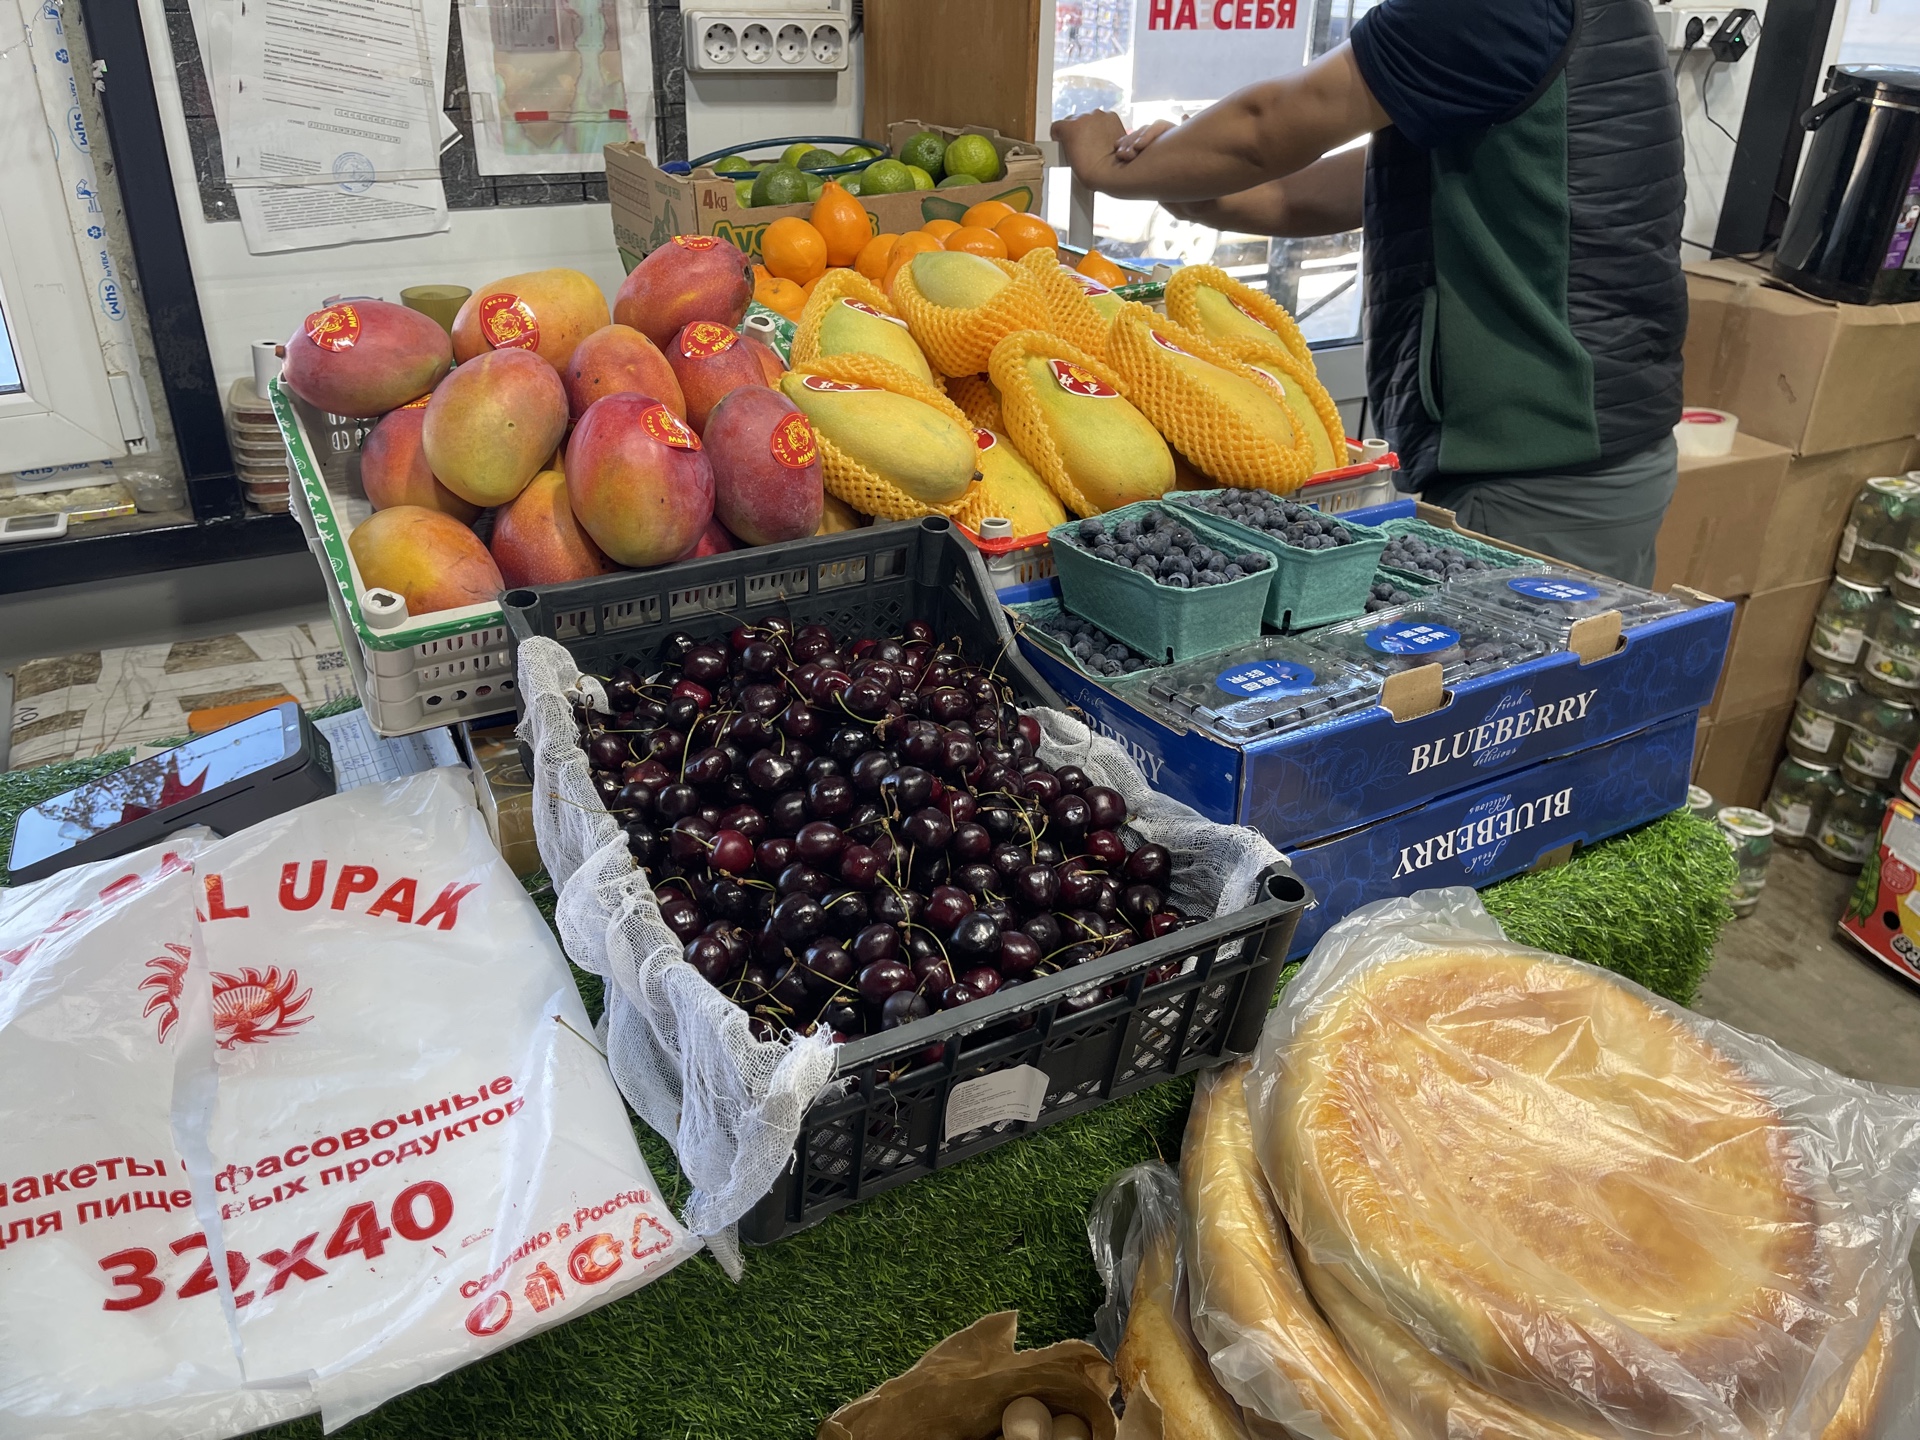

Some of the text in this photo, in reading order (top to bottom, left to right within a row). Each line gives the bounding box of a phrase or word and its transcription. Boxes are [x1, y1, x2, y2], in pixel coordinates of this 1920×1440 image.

[1148, 0, 1298, 30] НА СЕБЯ
[703, 189, 728, 212] 4kg
[99, 250, 111, 270] VEKA
[104, 284, 121, 315] whs
[1073, 688, 1104, 709] fresh
[1484, 688, 1532, 722] fresh
[1407, 688, 1599, 776] BLUEBERRY
[1472, 746, 1518, 768] delicious
[1468, 793, 1513, 815] delicious
[1391, 787, 1574, 880] BLUEBERRY
[1464, 839, 1507, 875] fresh
[277, 859, 481, 931] UPAK
[213, 1075, 515, 1195] фасовочные
[320, 1095, 526, 1189] продуктов
[459, 1231, 553, 1300] Сделано
[555, 1221, 572, 1243] в
[572, 1187, 653, 1233] России
